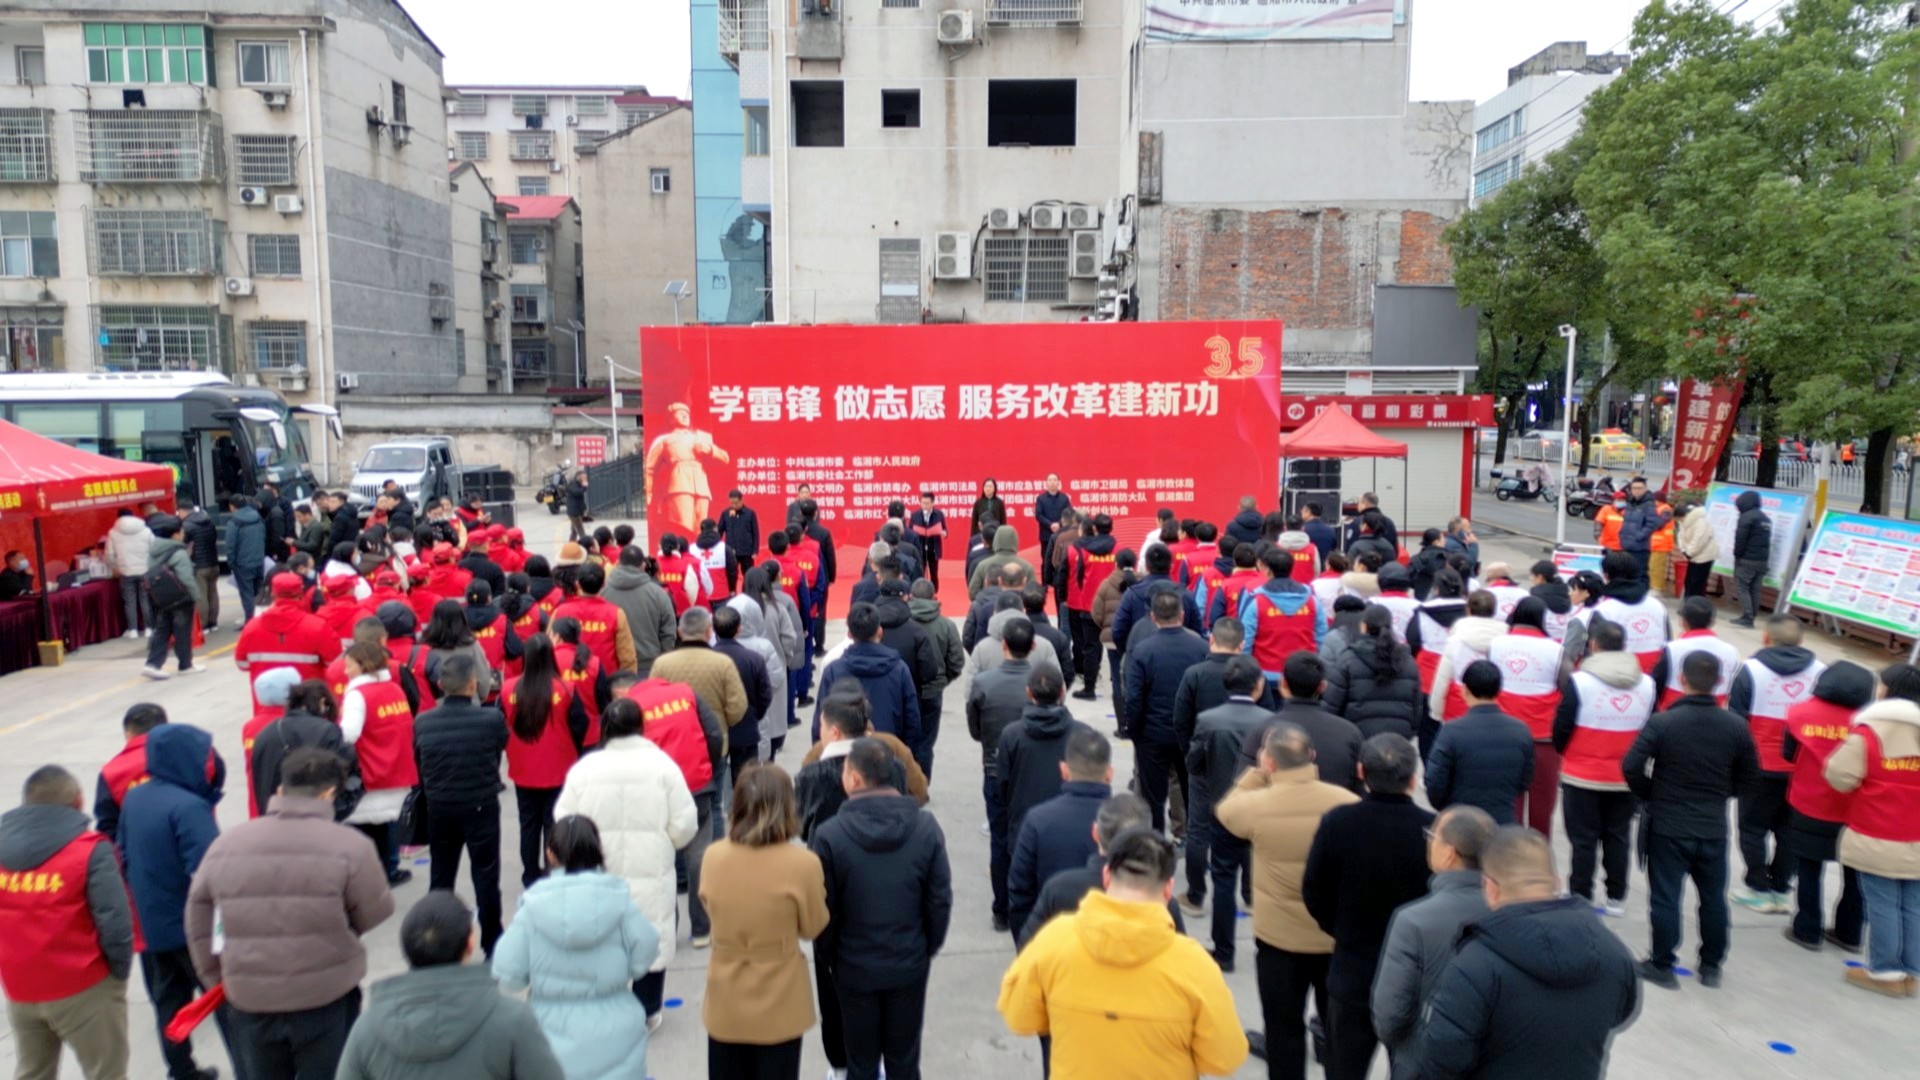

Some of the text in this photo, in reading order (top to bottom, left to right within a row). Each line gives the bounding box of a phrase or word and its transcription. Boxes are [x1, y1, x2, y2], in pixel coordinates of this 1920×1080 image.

[708, 381, 1219, 423] 学雷锋 做志愿 服务改革建新功
[785, 456, 844, 468] 中共临湘市委
[852, 455, 921, 467] 临湘市人民政府
[785, 469, 874, 480] 临湘市委社会工作部
[919, 481, 977, 492] 临湘市司法局
[1070, 480, 1128, 491] 临湘市卫健局
[1136, 478, 1194, 489] 临湘市教体局
[1080, 492, 1147, 503] 临湘市消防大队
